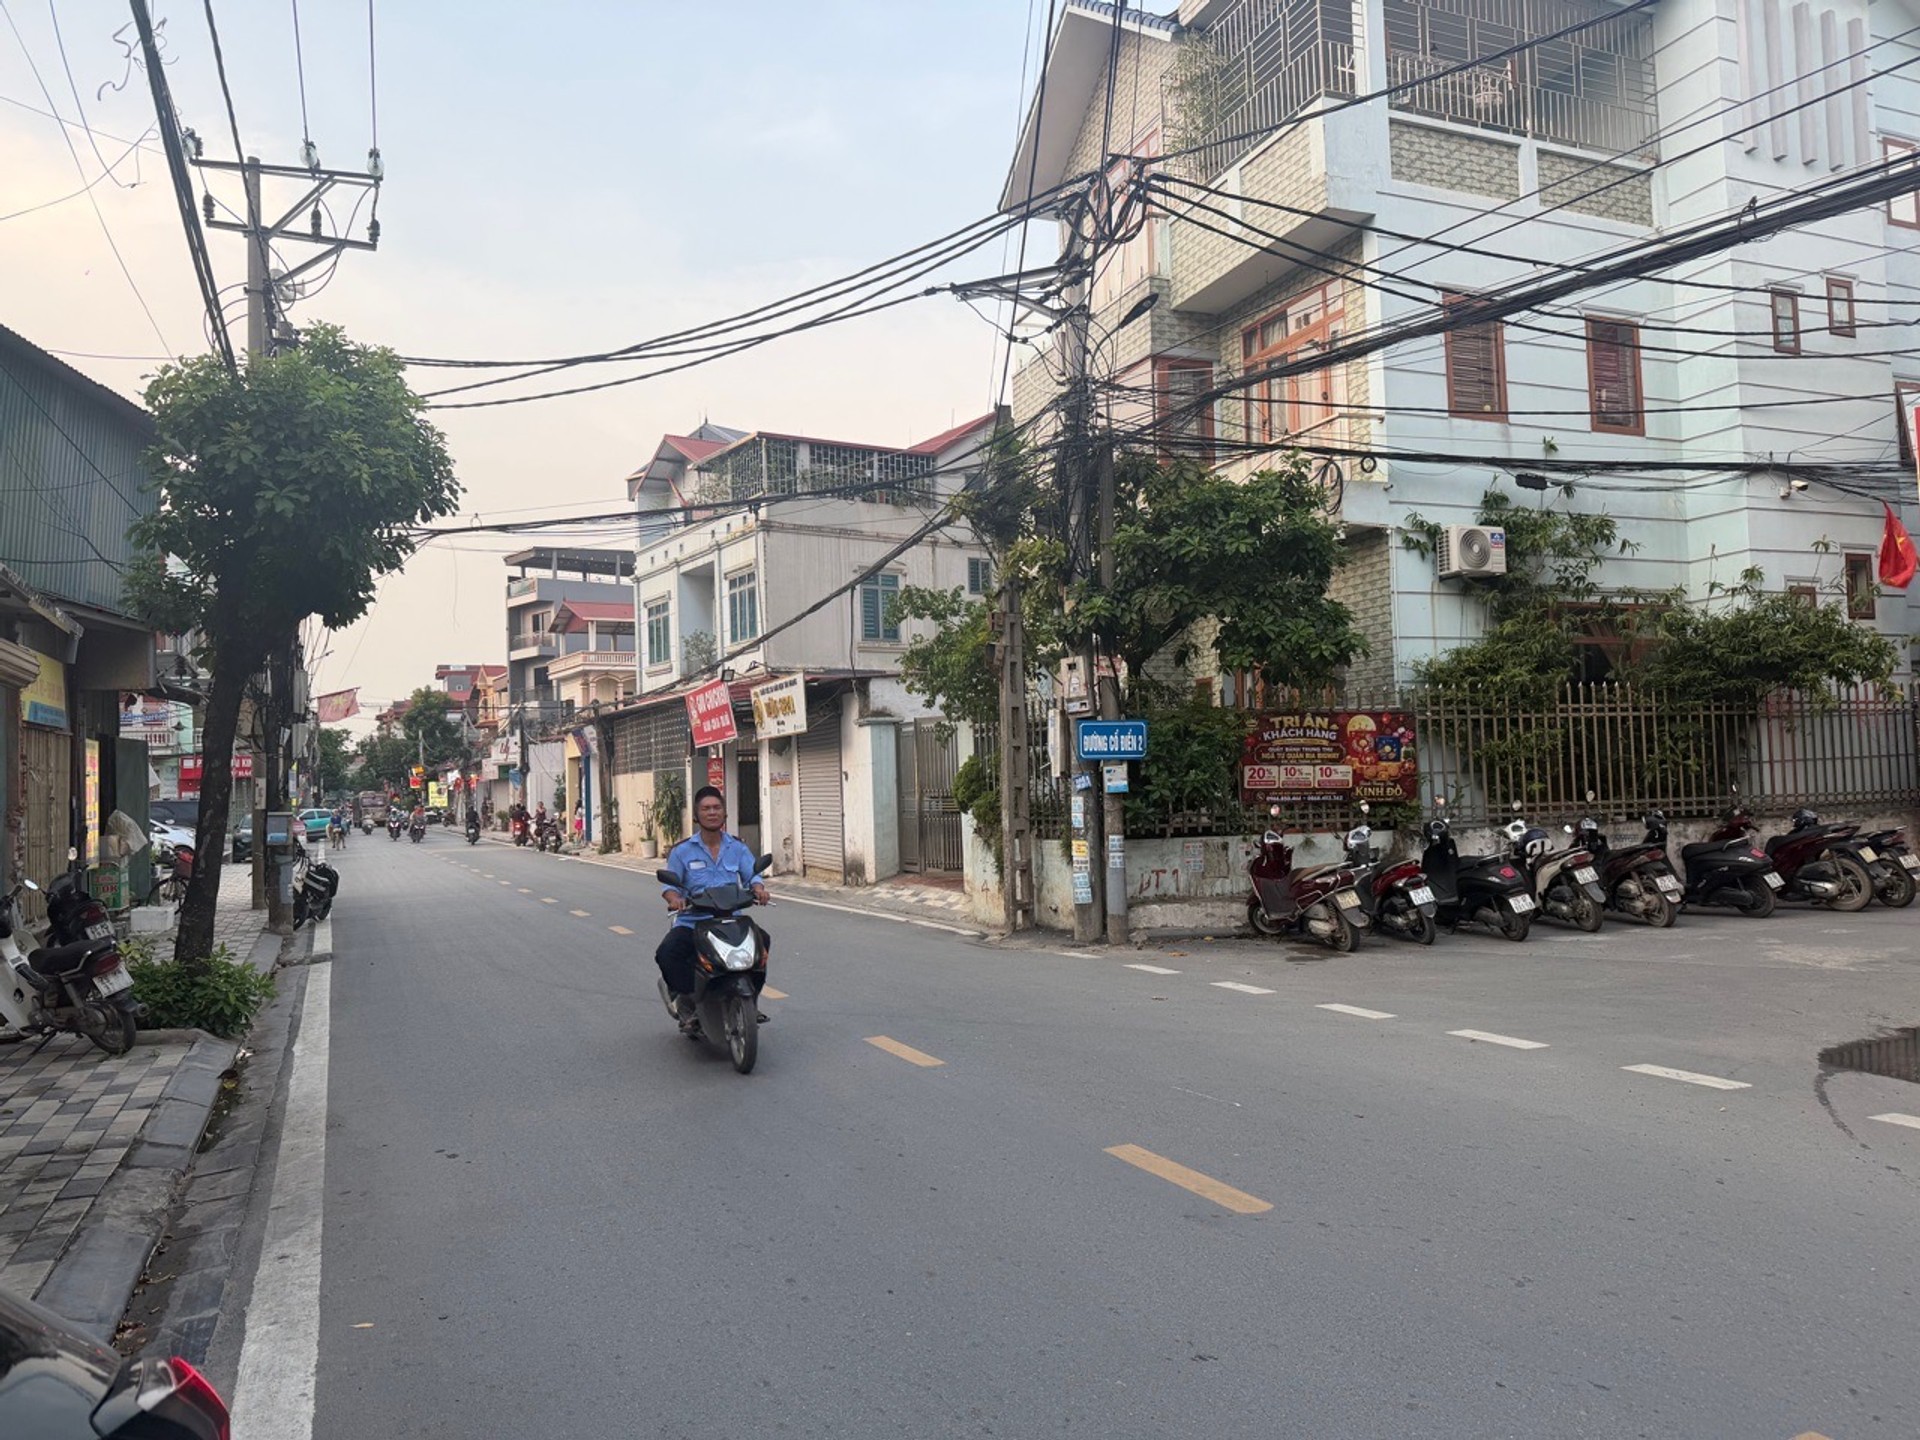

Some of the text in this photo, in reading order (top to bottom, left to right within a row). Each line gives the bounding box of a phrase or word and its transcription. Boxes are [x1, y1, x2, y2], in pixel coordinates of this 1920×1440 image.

[1269, 712, 1329, 729] TRI ÂN
[1262, 727, 1337, 741] KHÁCH HÀNG
[1138, 735, 1143, 752] 2
[1248, 767, 1273, 780] 20%
[1284, 767, 1304, 777] 10%
[1319, 766, 1339, 777] 10%
[1355, 786, 1384, 797] KINH
